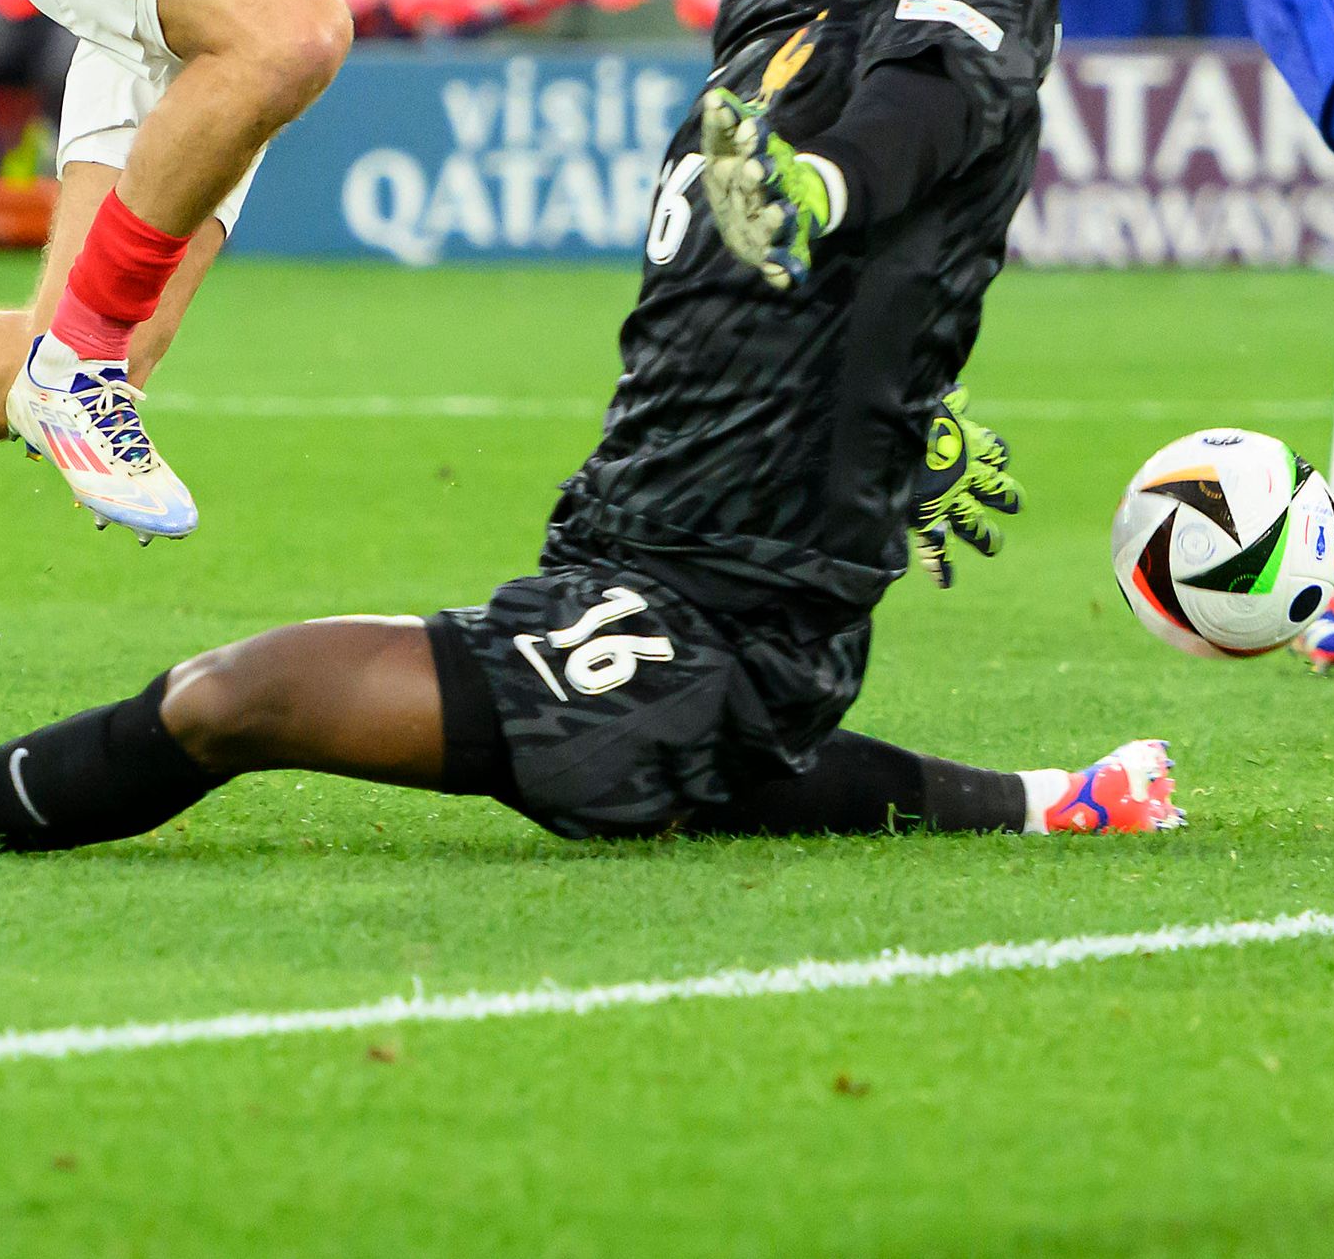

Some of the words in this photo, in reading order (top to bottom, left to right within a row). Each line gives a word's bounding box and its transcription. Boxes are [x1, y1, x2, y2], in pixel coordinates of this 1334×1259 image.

[441, 55, 685, 150] visit
[646, 152, 707, 265] 6
[546, 586, 676, 695] 16
